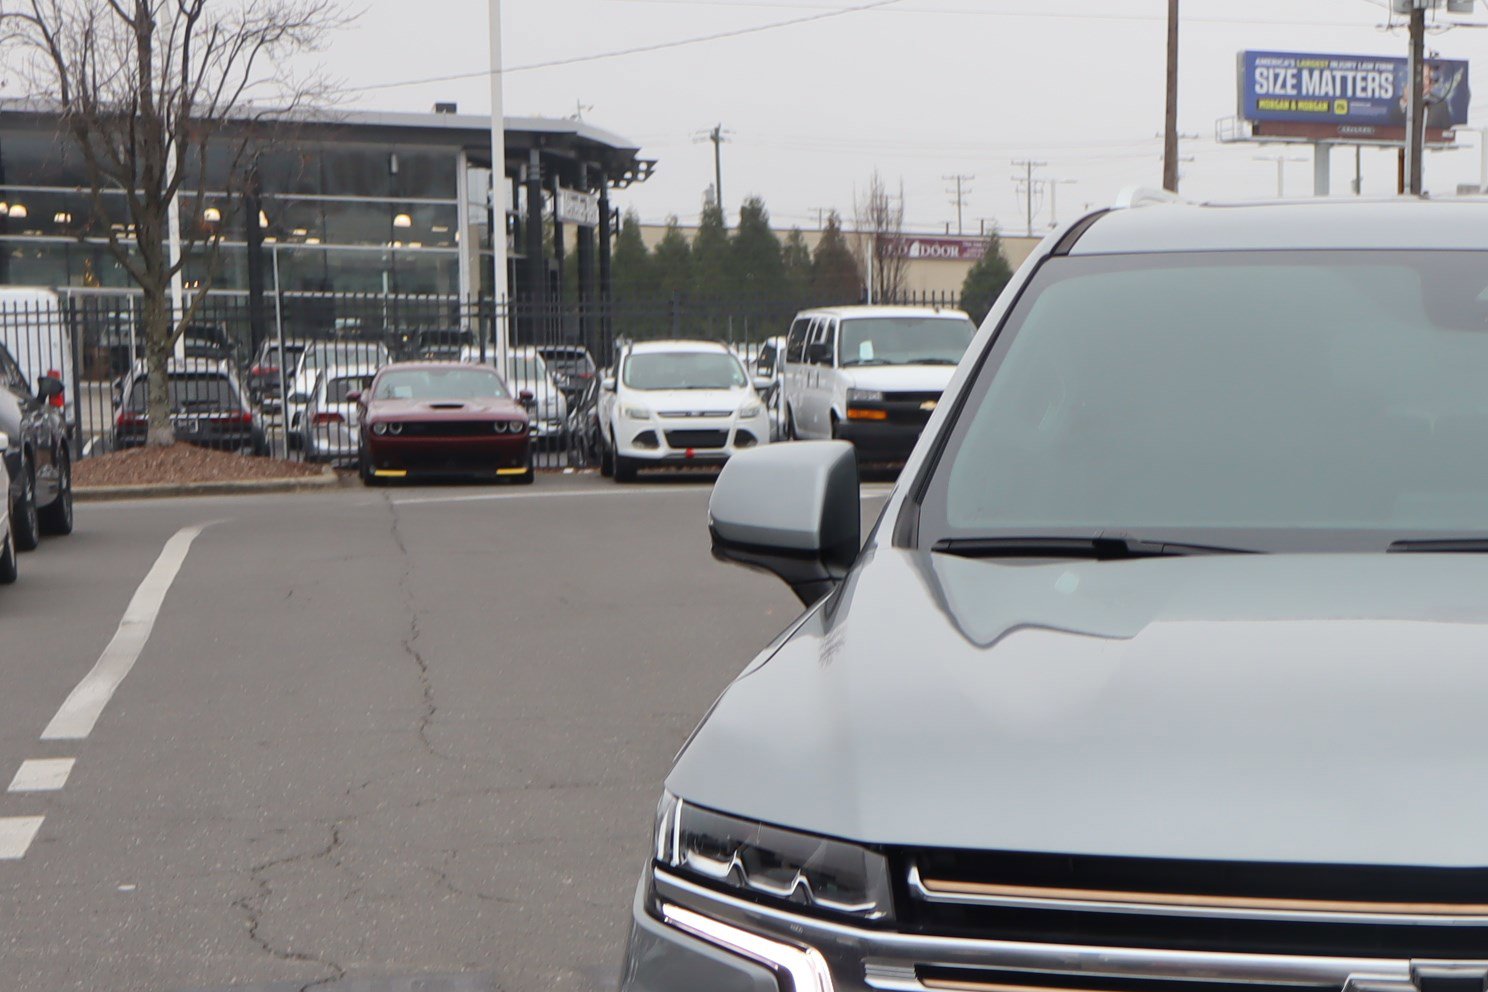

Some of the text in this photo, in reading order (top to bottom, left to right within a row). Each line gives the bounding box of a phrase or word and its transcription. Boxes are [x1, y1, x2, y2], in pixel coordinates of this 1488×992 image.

[1254, 67, 1394, 99] SIZE MATTERS
[920, 243, 960, 258] DOOR
